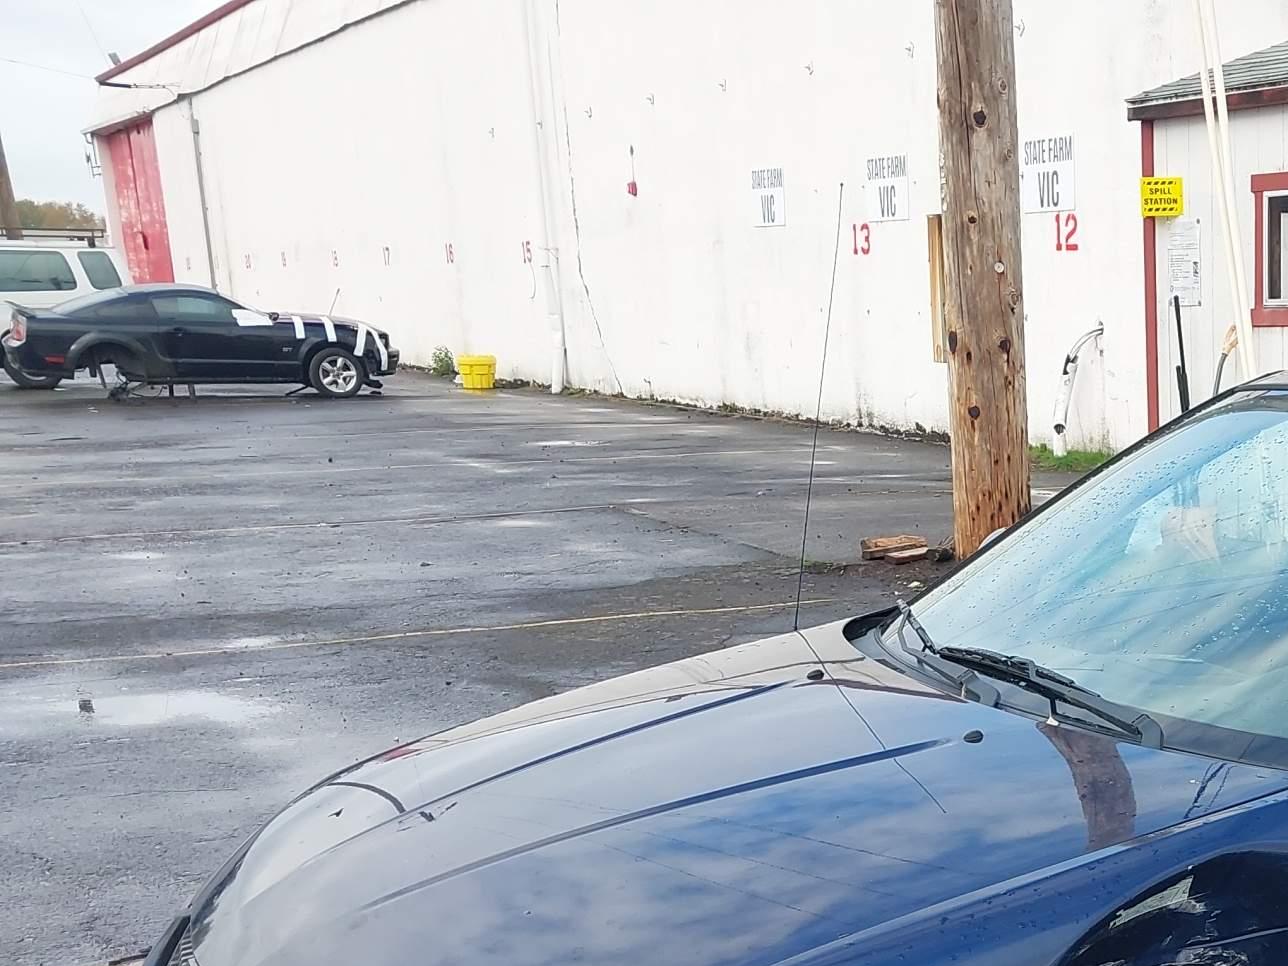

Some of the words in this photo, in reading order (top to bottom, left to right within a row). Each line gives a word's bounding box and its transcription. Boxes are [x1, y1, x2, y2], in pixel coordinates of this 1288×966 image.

[1024, 139, 1046, 166] STATE
[1048, 135, 1073, 163] FARM
[751, 169, 766, 190] STATE
[766, 167, 783, 189] FARM
[866, 158, 886, 181] STATE
[887, 154, 907, 178] FARM
[878, 185, 897, 218] VIC
[1038, 170, 1060, 208] VIC
[1143, 197, 1178, 206] STATION
[1149, 187, 1172, 195] SPILL
[760, 194, 776, 224] VIC
[852, 223, 871, 255] 13
[1055, 213, 1079, 251] 12
[382, 246, 390, 266] 17
[444, 243, 455, 264] 16
[521, 240, 533, 264] 15
